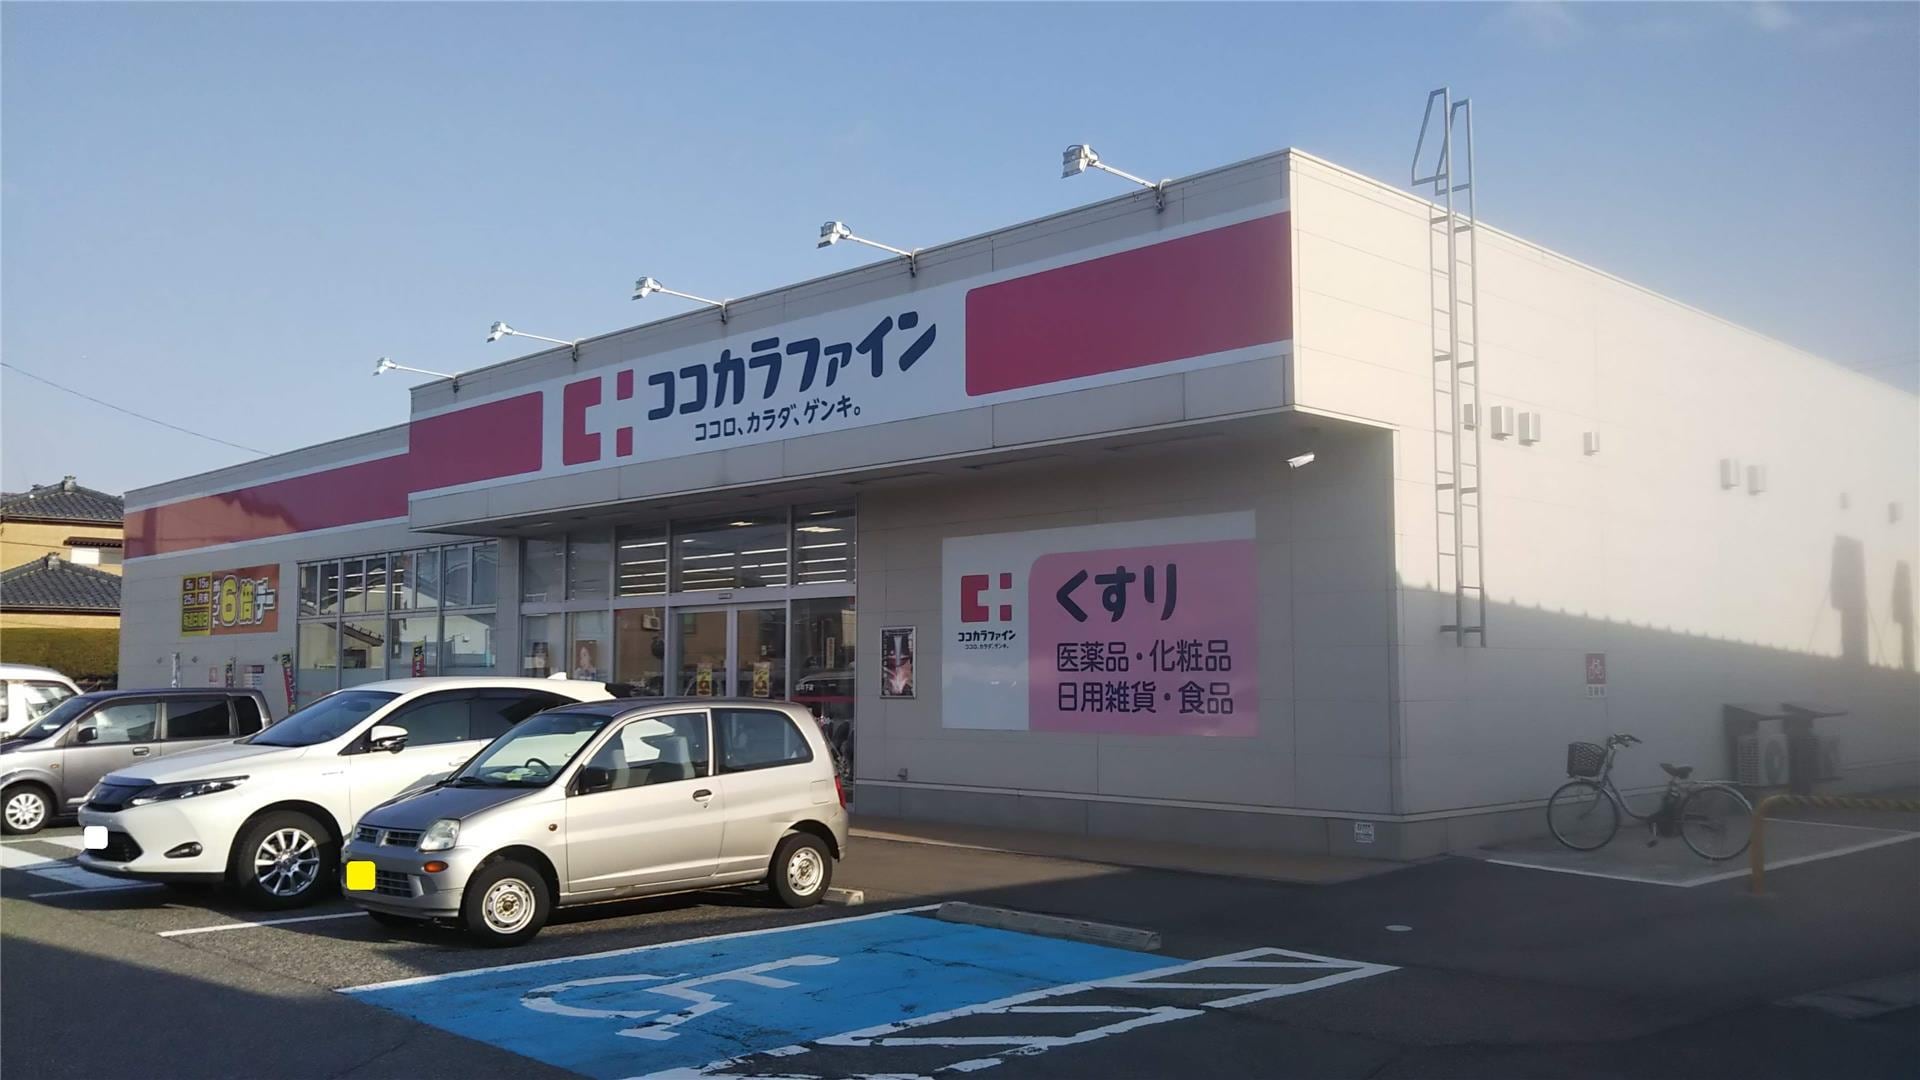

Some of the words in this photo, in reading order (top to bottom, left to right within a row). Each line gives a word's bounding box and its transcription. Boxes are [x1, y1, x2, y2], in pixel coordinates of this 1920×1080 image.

[648, 311, 937, 420] ココカラファイン
[695, 395, 862, 442] ココロ、カラダ、ゲンキ。
[1056, 563, 1178, 623] くすり
[958, 630, 1016, 642] ココカラファイン
[1056, 639, 1232, 673] 医薬品・化粧品
[1058, 681, 1234, 715] 日用雑貨・食品
